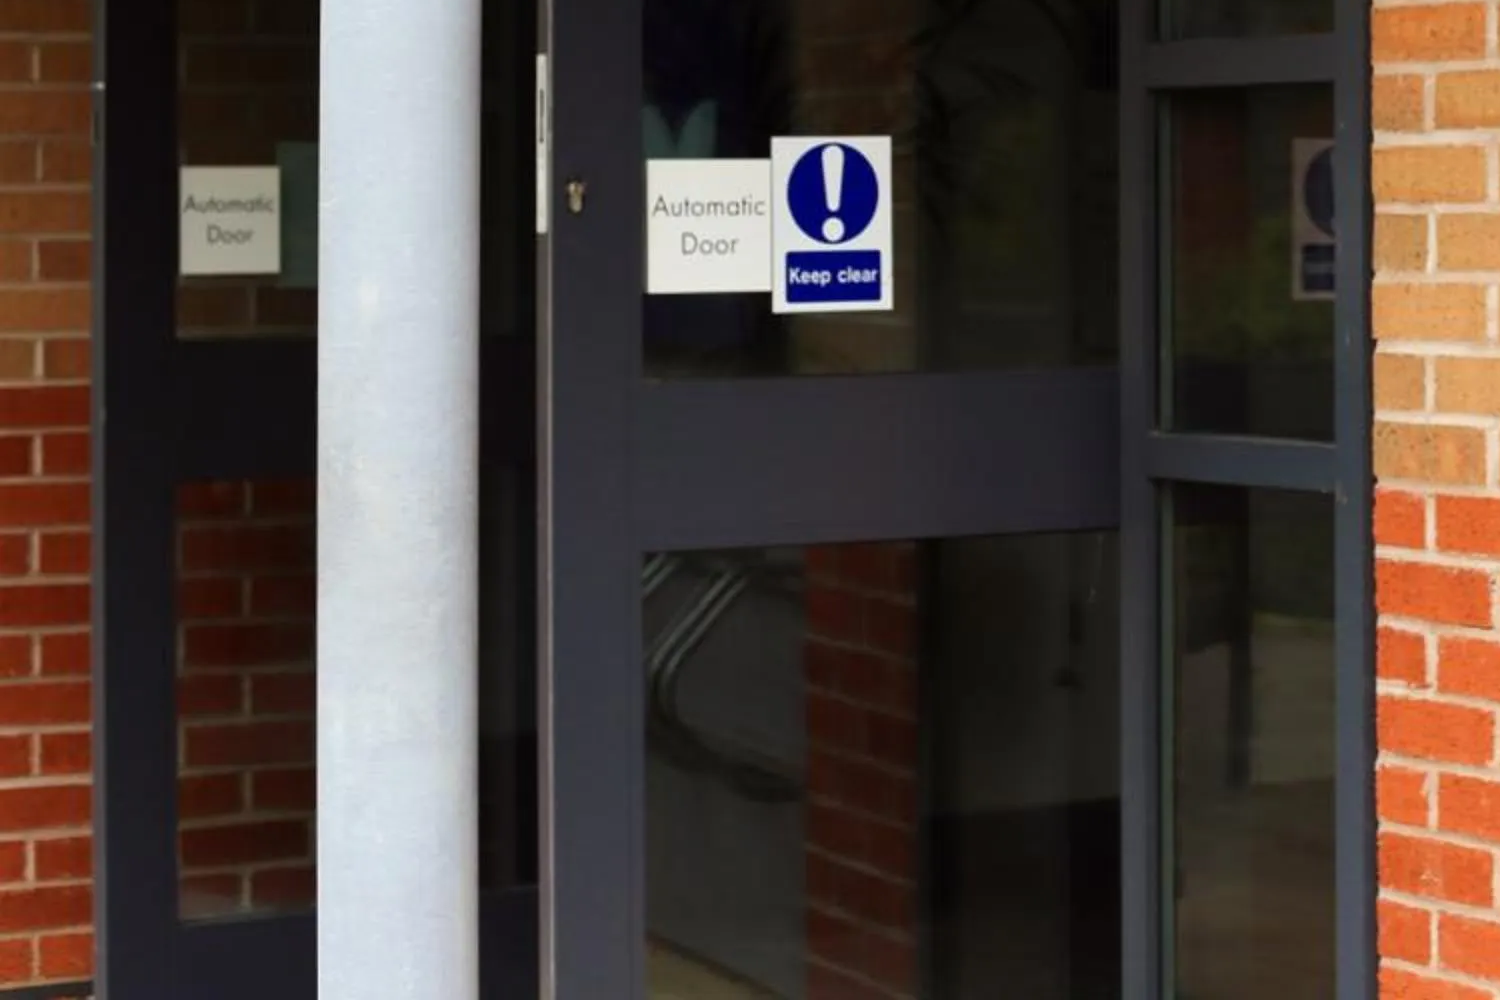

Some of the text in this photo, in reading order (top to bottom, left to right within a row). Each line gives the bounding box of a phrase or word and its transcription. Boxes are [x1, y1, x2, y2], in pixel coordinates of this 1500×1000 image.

[183, 194, 274, 213] Automatic
[652, 195, 766, 217] Automatic
[206, 224, 254, 245] Door
[681, 231, 739, 256] Door
[789, 266, 878, 287] Keep clear
